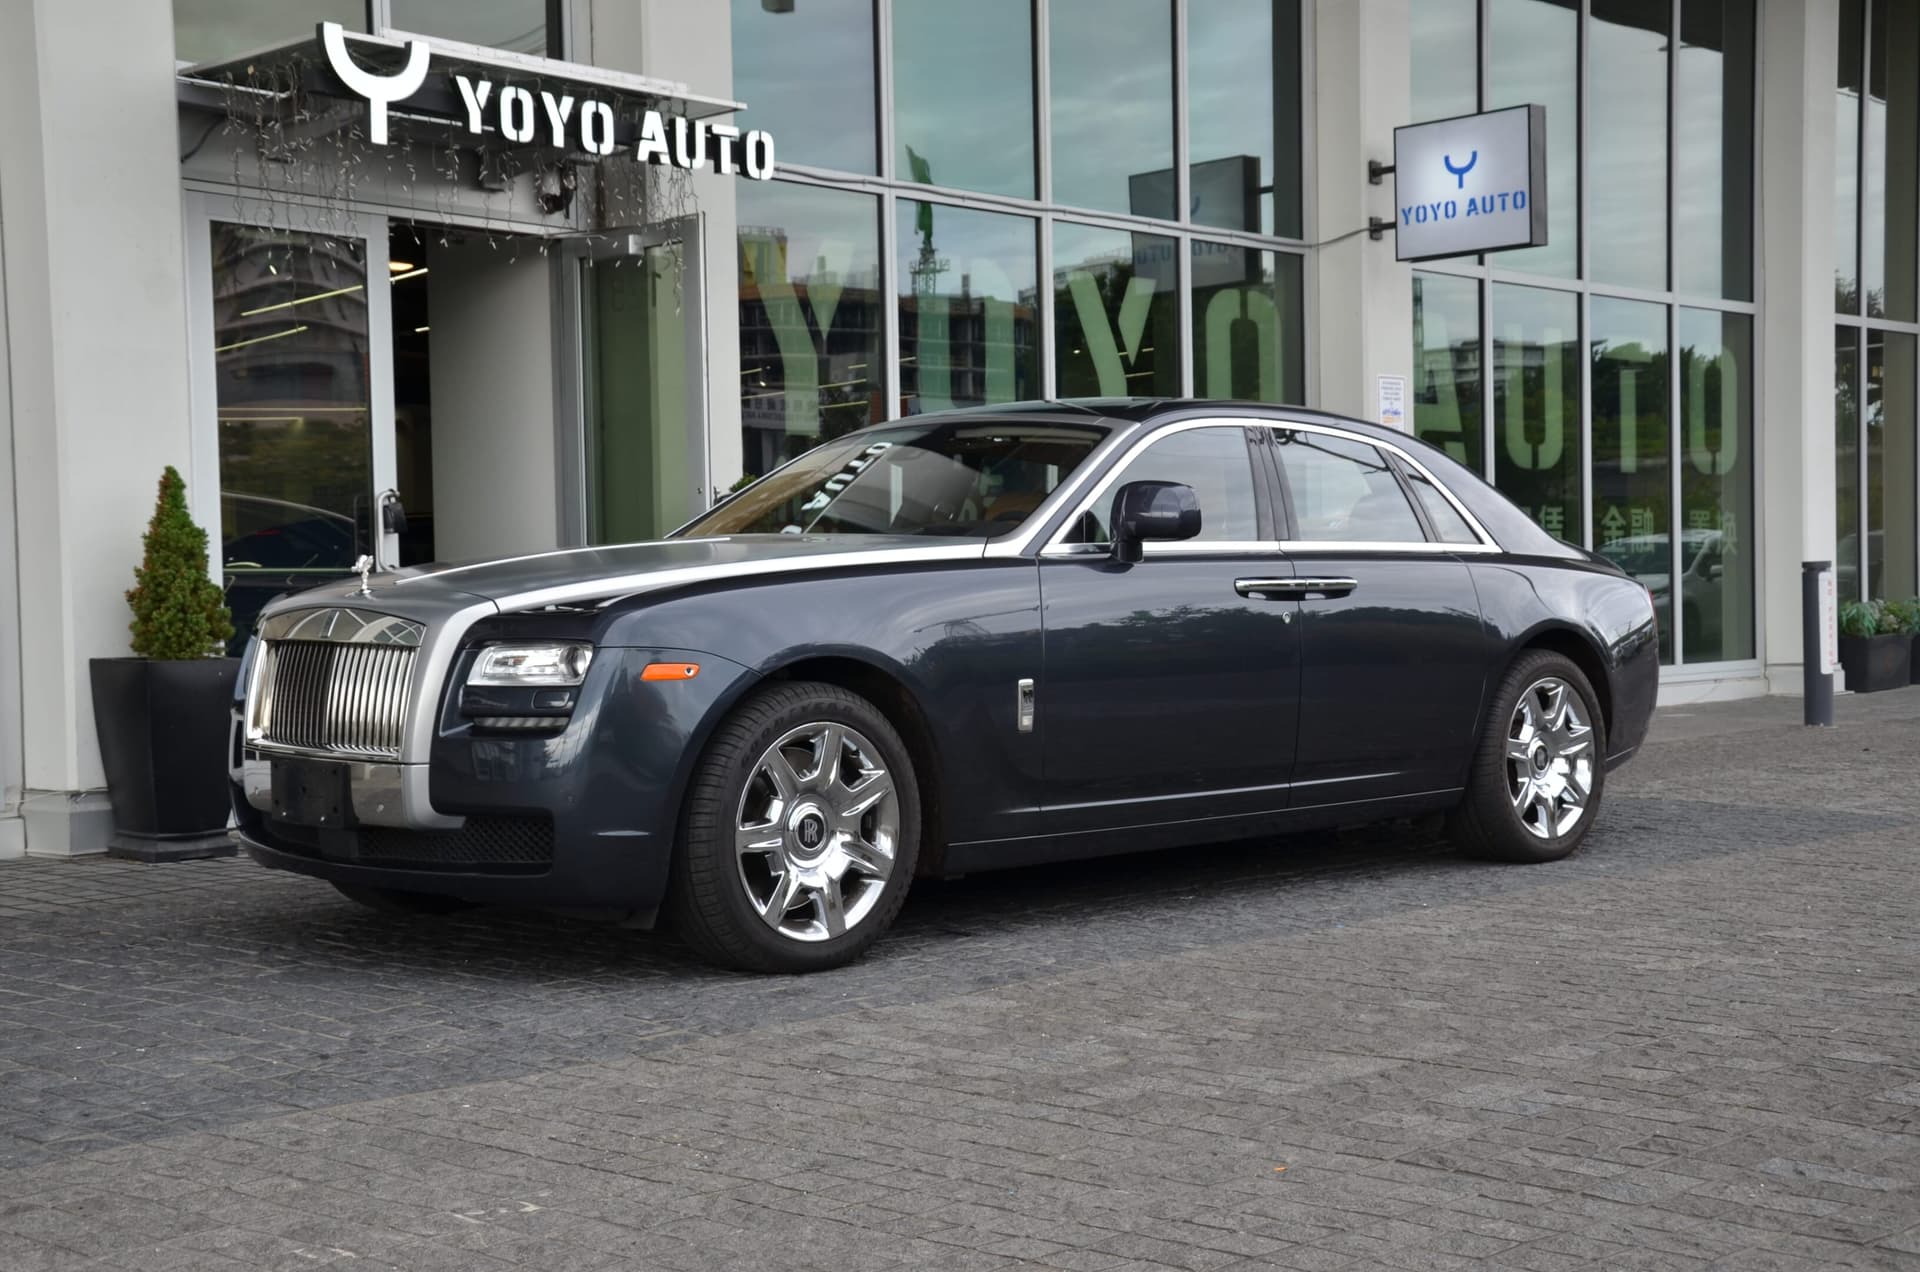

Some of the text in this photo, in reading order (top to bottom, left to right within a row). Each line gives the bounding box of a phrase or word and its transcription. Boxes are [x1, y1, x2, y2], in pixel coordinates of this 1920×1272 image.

[455, 75, 774, 181] YOYO AUTO
[1401, 190, 1526, 226] YOYO AUTO
[1601, 505, 1655, 553] 金融
